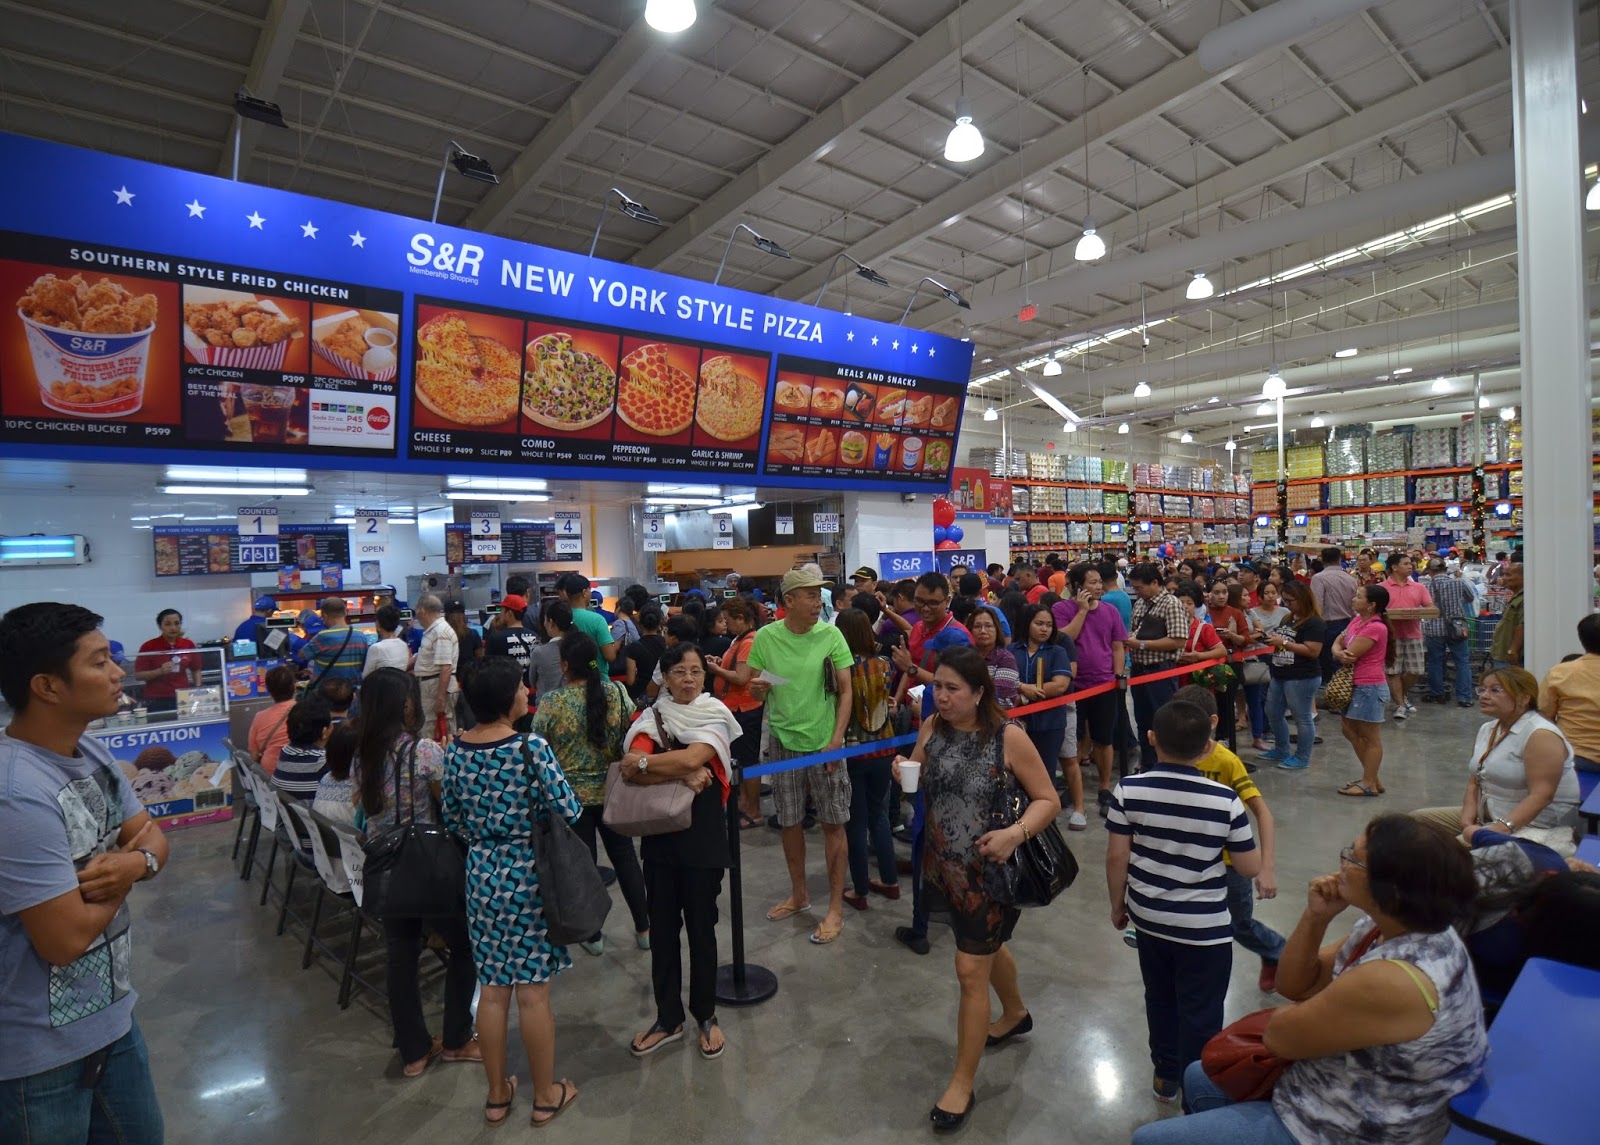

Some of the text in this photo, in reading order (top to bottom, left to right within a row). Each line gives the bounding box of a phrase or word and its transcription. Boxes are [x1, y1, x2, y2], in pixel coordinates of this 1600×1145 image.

[406, 233, 484, 277] S&R
[70, 248, 348, 299] SOUTHERN STYLE FRIED CHICKEN
[409, 266, 478, 286] Membership Shopping
[501, 259, 823, 344] NEW YORK STYLE PIZZA
[70, 337, 106, 352] S&R
[206, 368, 244, 378] CHICKEN
[282, 374, 304, 384] P399
[838, 368, 916, 387] MEALS AND SNACKS
[328, 378, 356, 386] CHICKEN
[372, 384, 392, 392] P149
[5, 420, 127, 434] 10 PC CHICKEN BUCKET
[145, 427, 171, 436] P599
[414, 432, 451, 443] CHEESE
[521, 438, 555, 449] COMBO
[414, 445, 440, 453] WHOLE
[456, 447, 473, 455] P499
[613, 445, 650, 454] PEPPERONI
[692, 450, 714, 459] GARLIC
[721, 452, 743, 460] SHRIMP
[814, 514, 838, 523] CLAIM
[1294, 515, 1305, 525] 17
[252, 517, 262, 533] 1
[367, 518, 378, 533] 2
[481, 519, 491, 533] 3
[564, 520, 572, 533] 4
[651, 520, 658, 532] 5
[719, 520, 726, 532] 6
[782, 522, 788, 533] 7
[816, 523, 837, 532] HERE
[892, 558, 921, 571] S&R
[950, 554, 975, 566] S&R
[99, 727, 200, 749] NG STATION
[148, 803, 170, 815] NY
